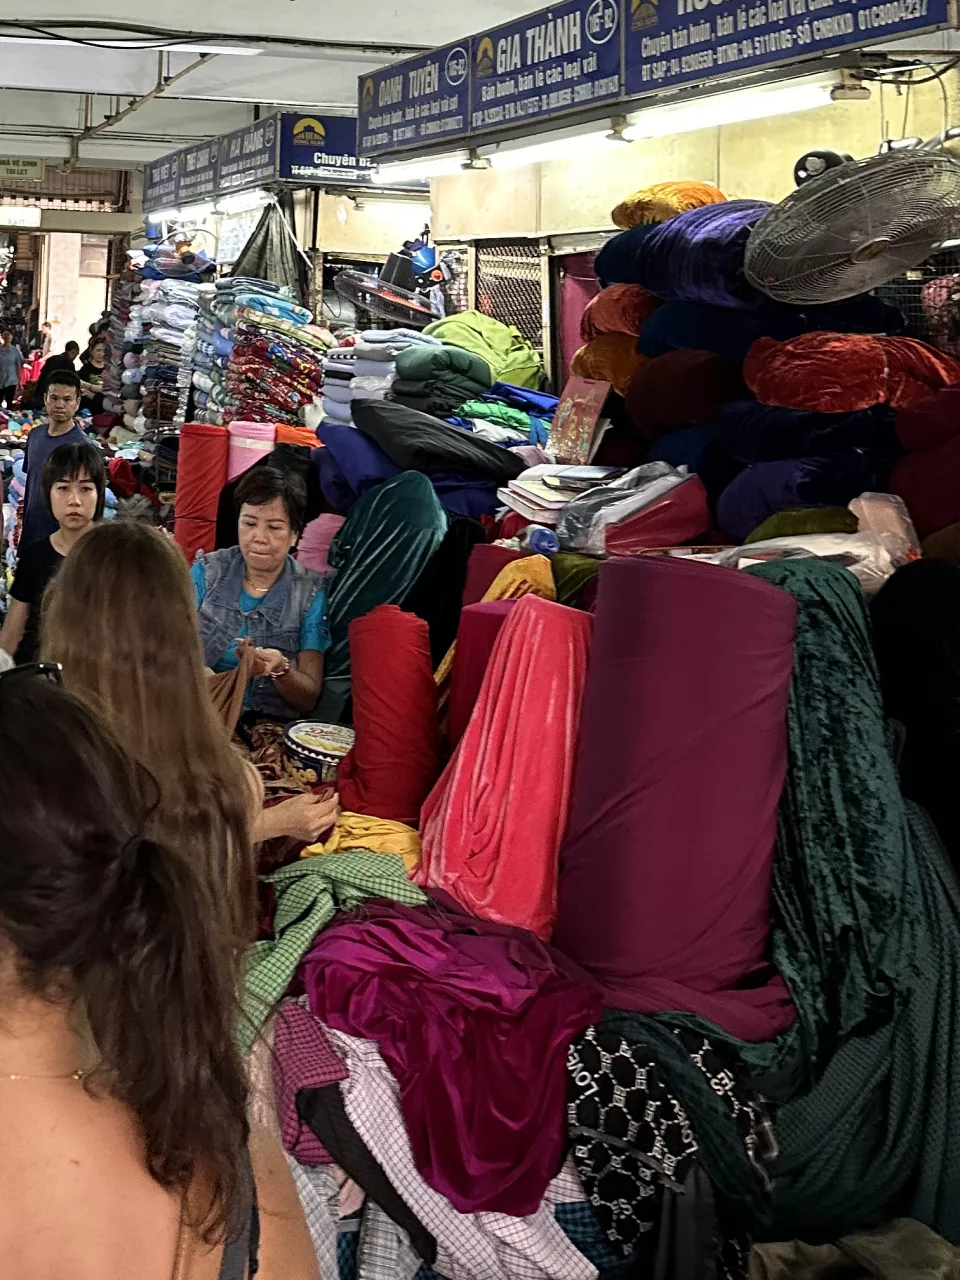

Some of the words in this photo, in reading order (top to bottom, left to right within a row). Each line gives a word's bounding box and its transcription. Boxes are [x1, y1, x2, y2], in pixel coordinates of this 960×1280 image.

[496, 33, 520, 74] GIA
[525, 10, 580, 65] THÀNH
[313, 152, 356, 167] Chuyên
